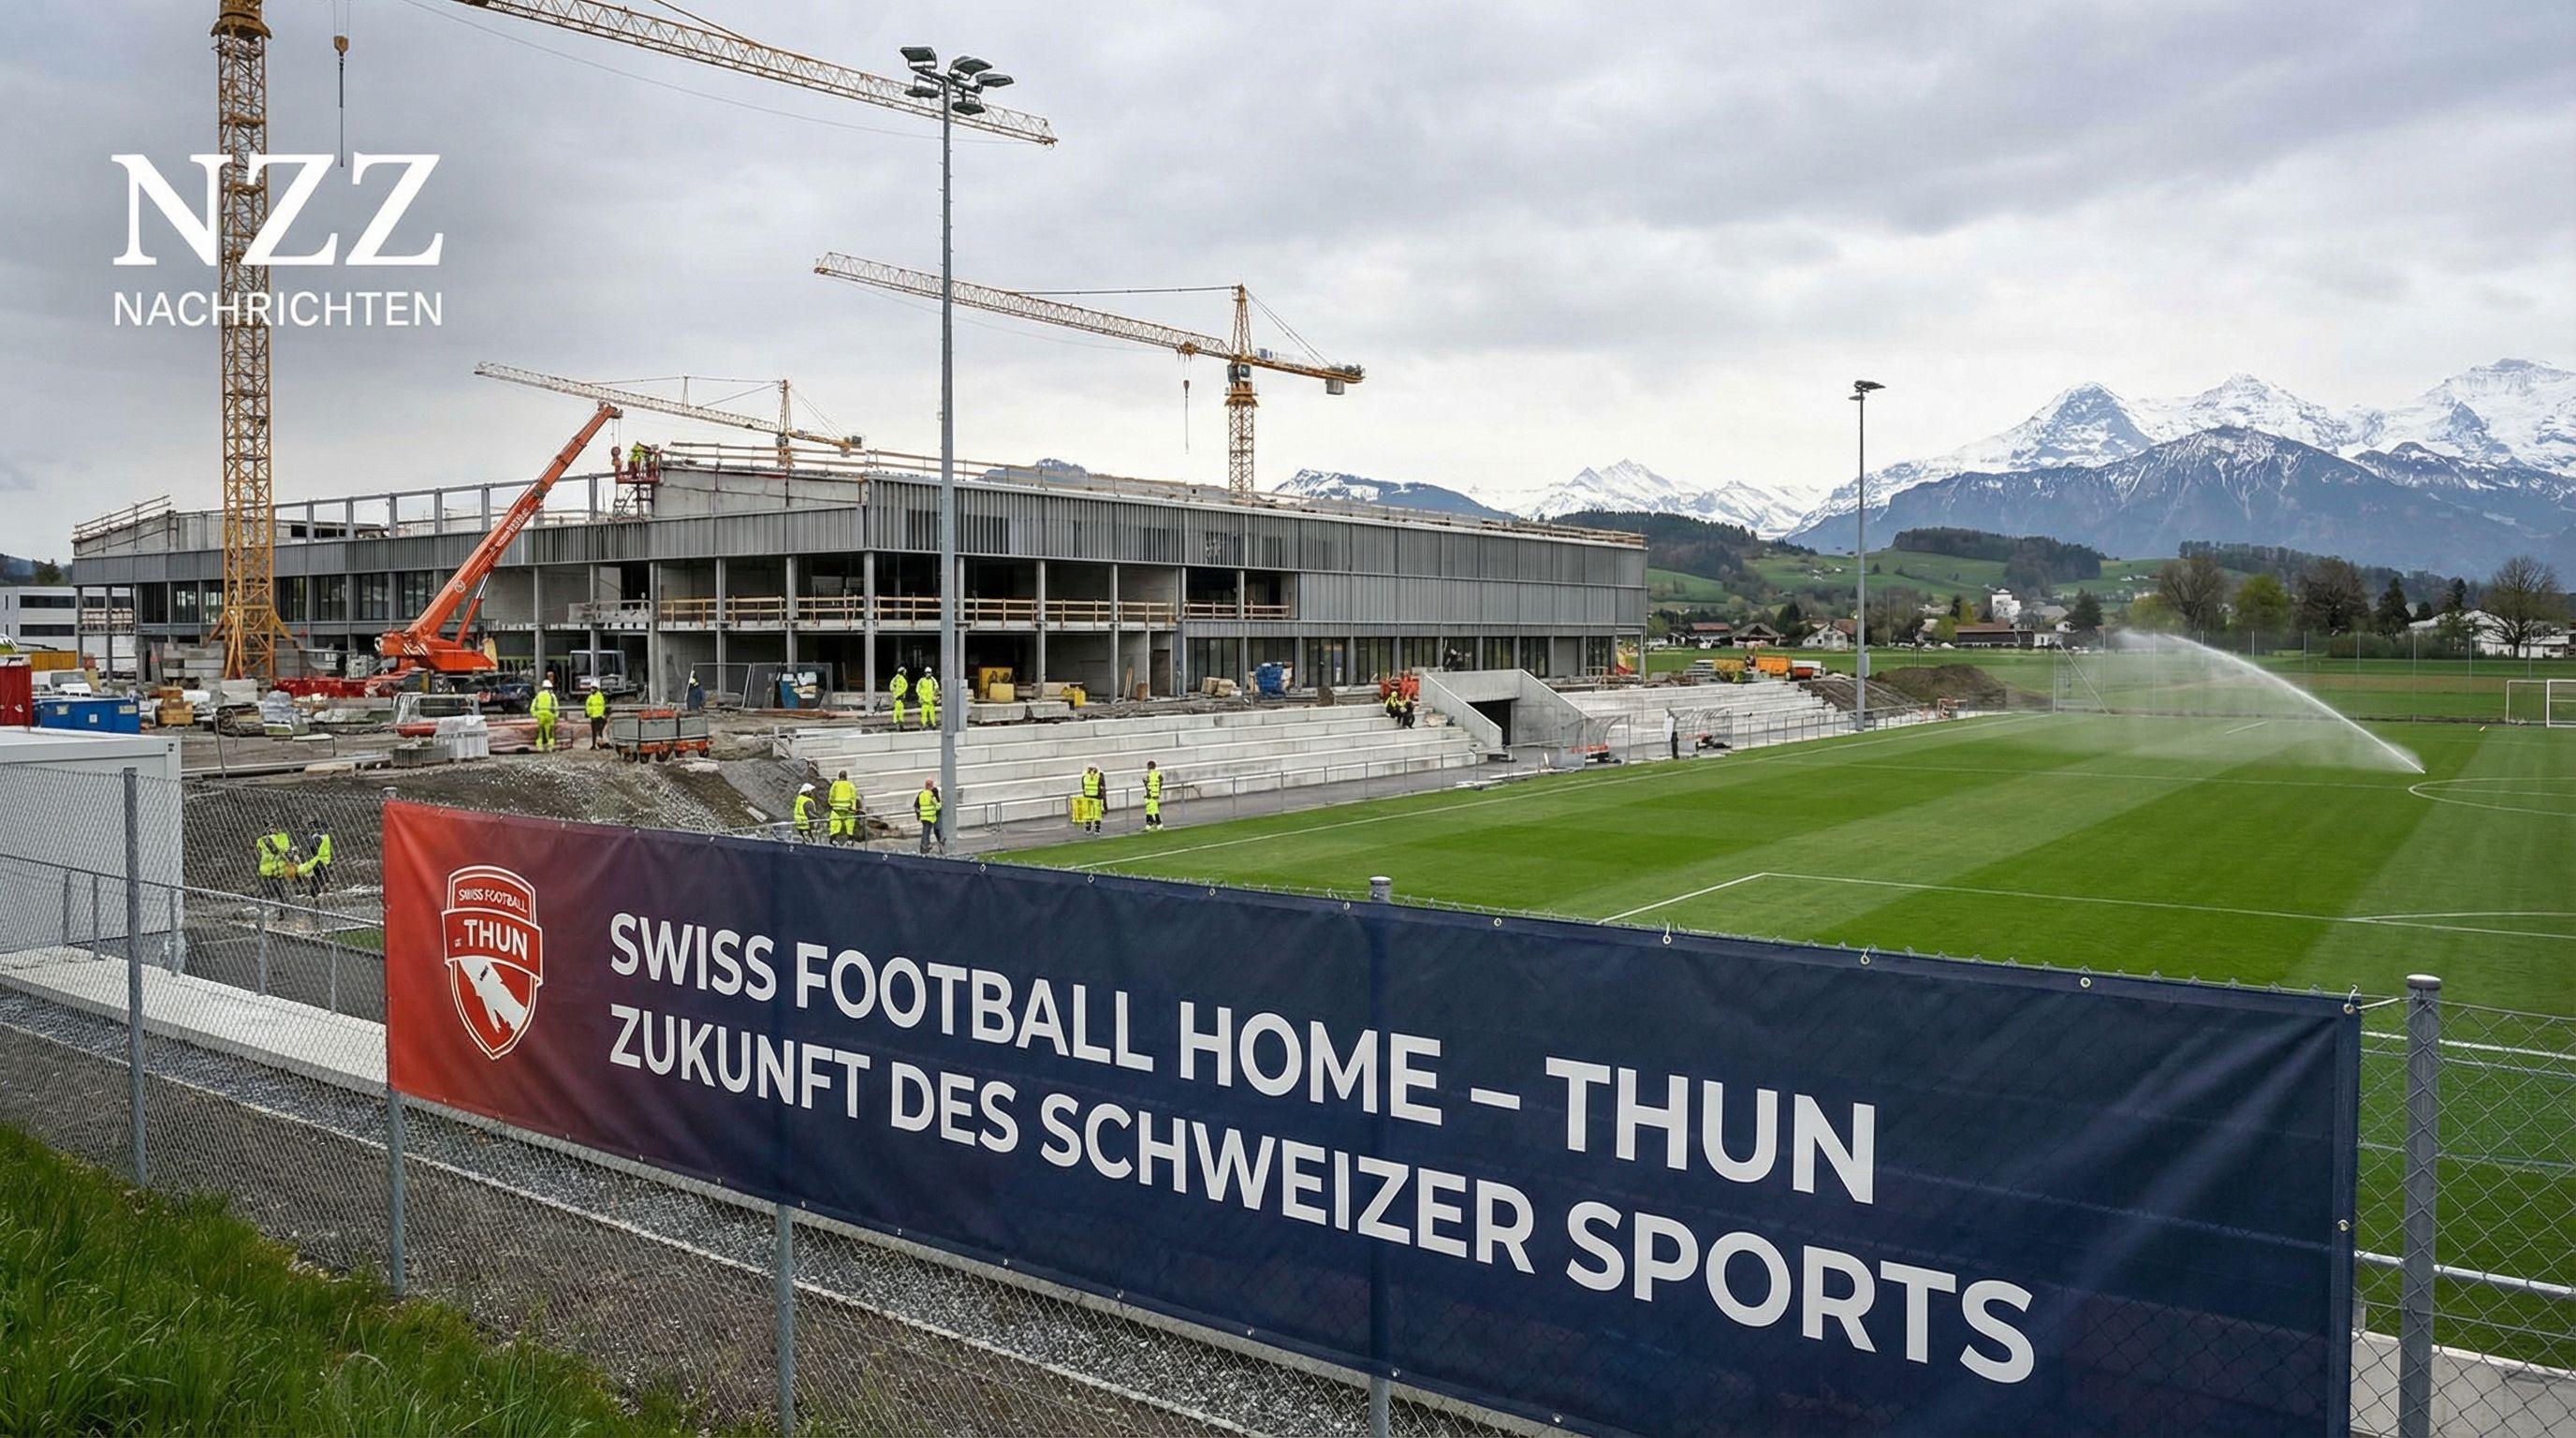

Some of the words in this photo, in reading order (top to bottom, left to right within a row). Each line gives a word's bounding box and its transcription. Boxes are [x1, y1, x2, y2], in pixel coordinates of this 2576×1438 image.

[463, 918, 528, 961] THUN
[609, 913, 778, 1003] SWISS
[796, 941, 1154, 1073] FOOTBALL
[1178, 1000, 1443, 1127] HOME
[1544, 1055, 1876, 1206] THUN
[608, 1002, 871, 1120] ZUKUNFT
[890, 1060, 1019, 1153] DES
[1039, 1092, 1536, 1275] SCHWEIZER
[1565, 1200, 2035, 1385] SPORTS
